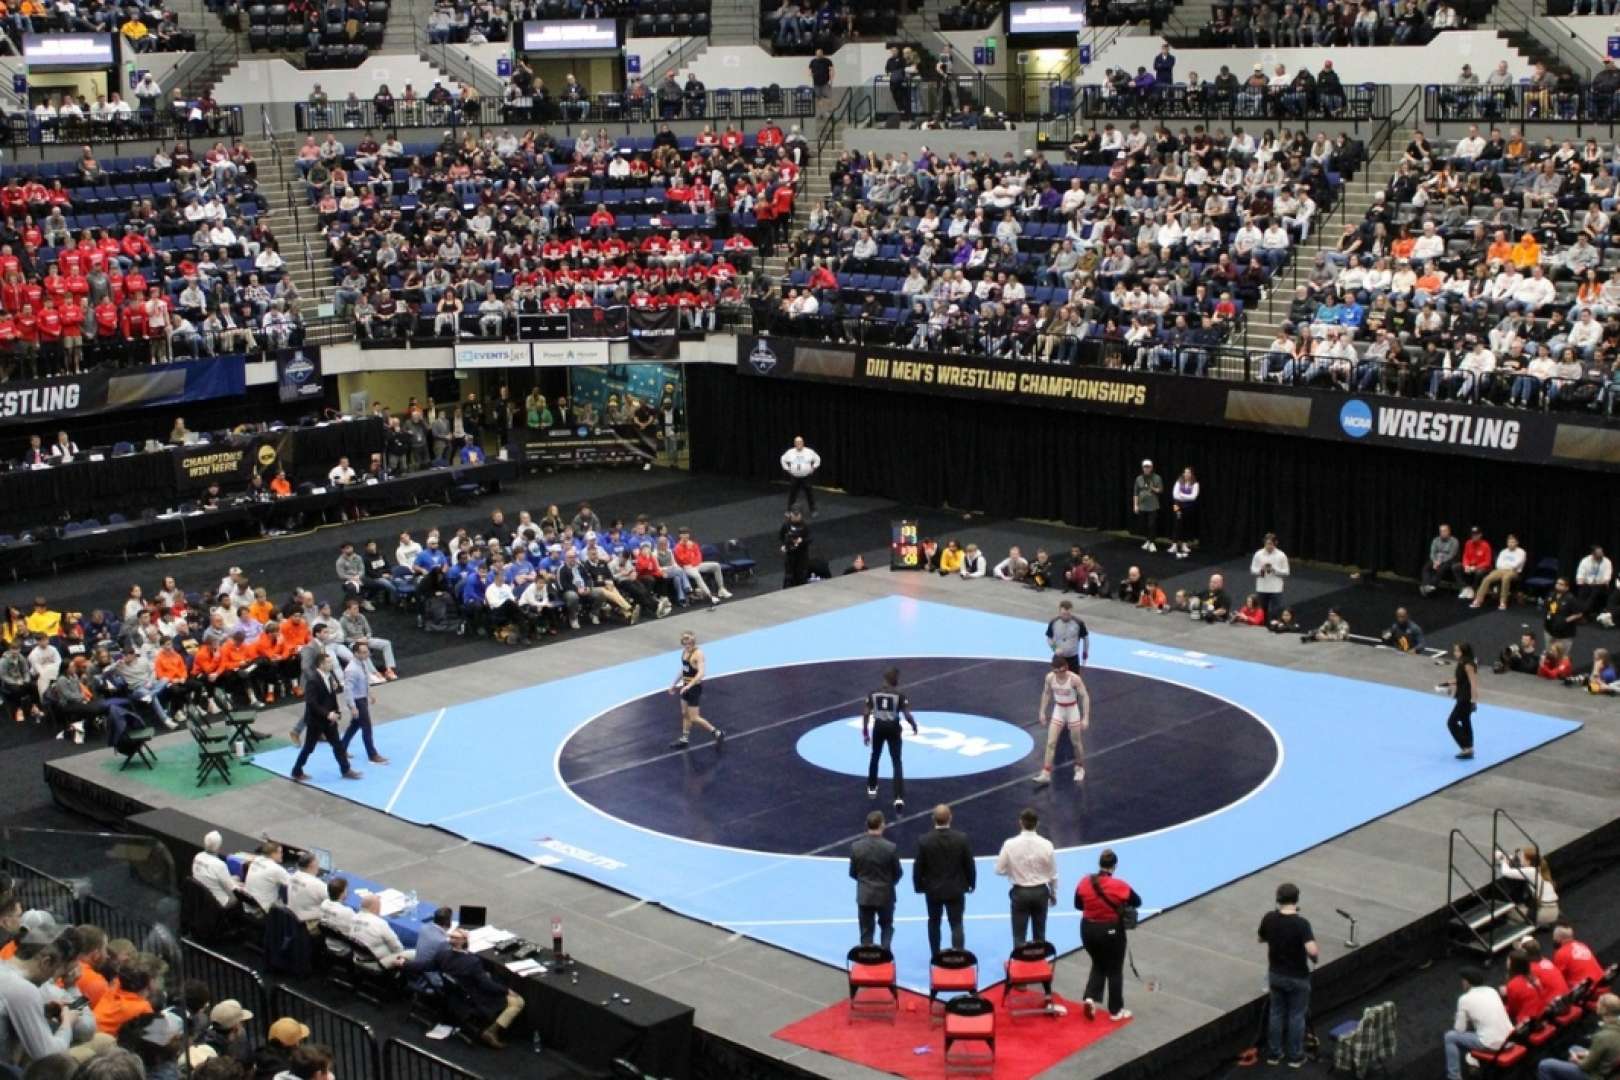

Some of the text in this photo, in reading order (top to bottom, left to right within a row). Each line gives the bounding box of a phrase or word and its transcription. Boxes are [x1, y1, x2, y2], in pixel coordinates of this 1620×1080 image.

[0, 384, 80, 417] STLING
[892, 361, 934, 383] MEN'S
[937, 365, 1016, 392] WRESTLING
[1020, 373, 1147, 405] CHAMPIONSHIPS
[1378, 407, 1520, 450] WRESTLING
[183, 451, 243, 468] CHAMPIONS
